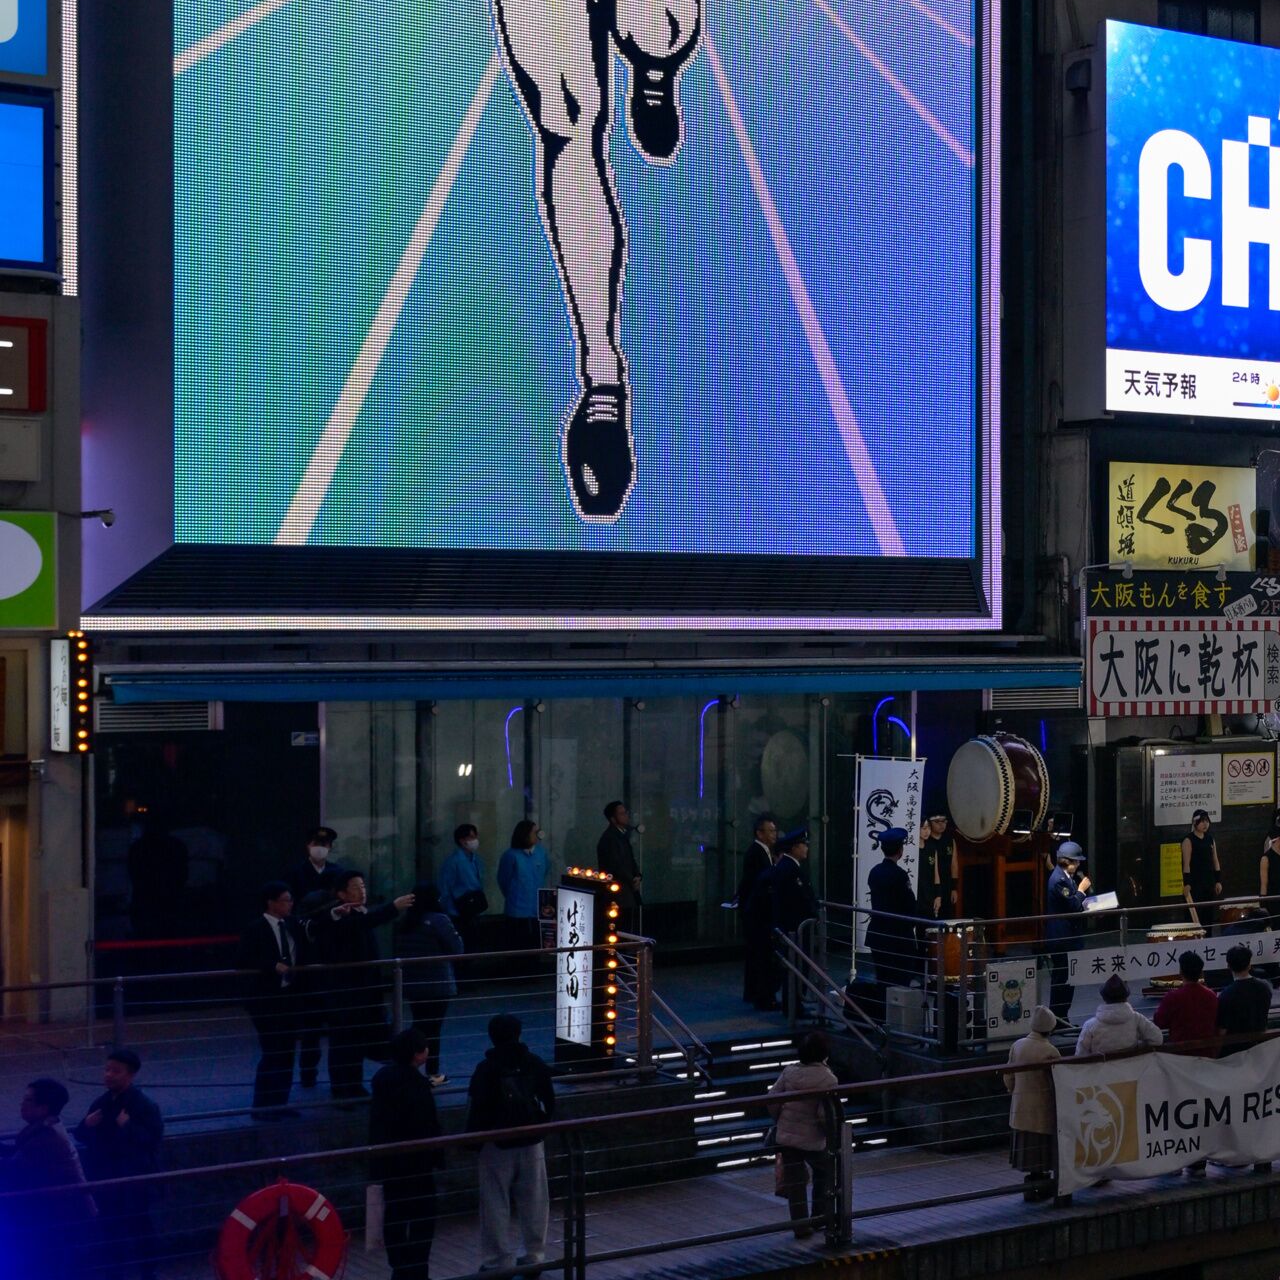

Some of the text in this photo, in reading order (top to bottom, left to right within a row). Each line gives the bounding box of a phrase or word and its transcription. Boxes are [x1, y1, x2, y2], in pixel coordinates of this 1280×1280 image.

[1124, 369, 1197, 400] 天気予報
[1232, 371, 1260, 386] 24時
[1117, 474, 1136, 557] 道頓堀
[1136, 477, 1229, 555] くくる
[1168, 556, 1200, 566] KUKURU
[1090, 580, 1232, 609] 大阪もんを食す
[1099, 633, 1259, 698] 大阪に乾杯
[1267, 643, 1280, 685] 検索
[903, 769, 919, 879] 大阪高等学校 和太
[1145, 1095, 1231, 1134] MGM
[1146, 1136, 1201, 1159] JAPAN
